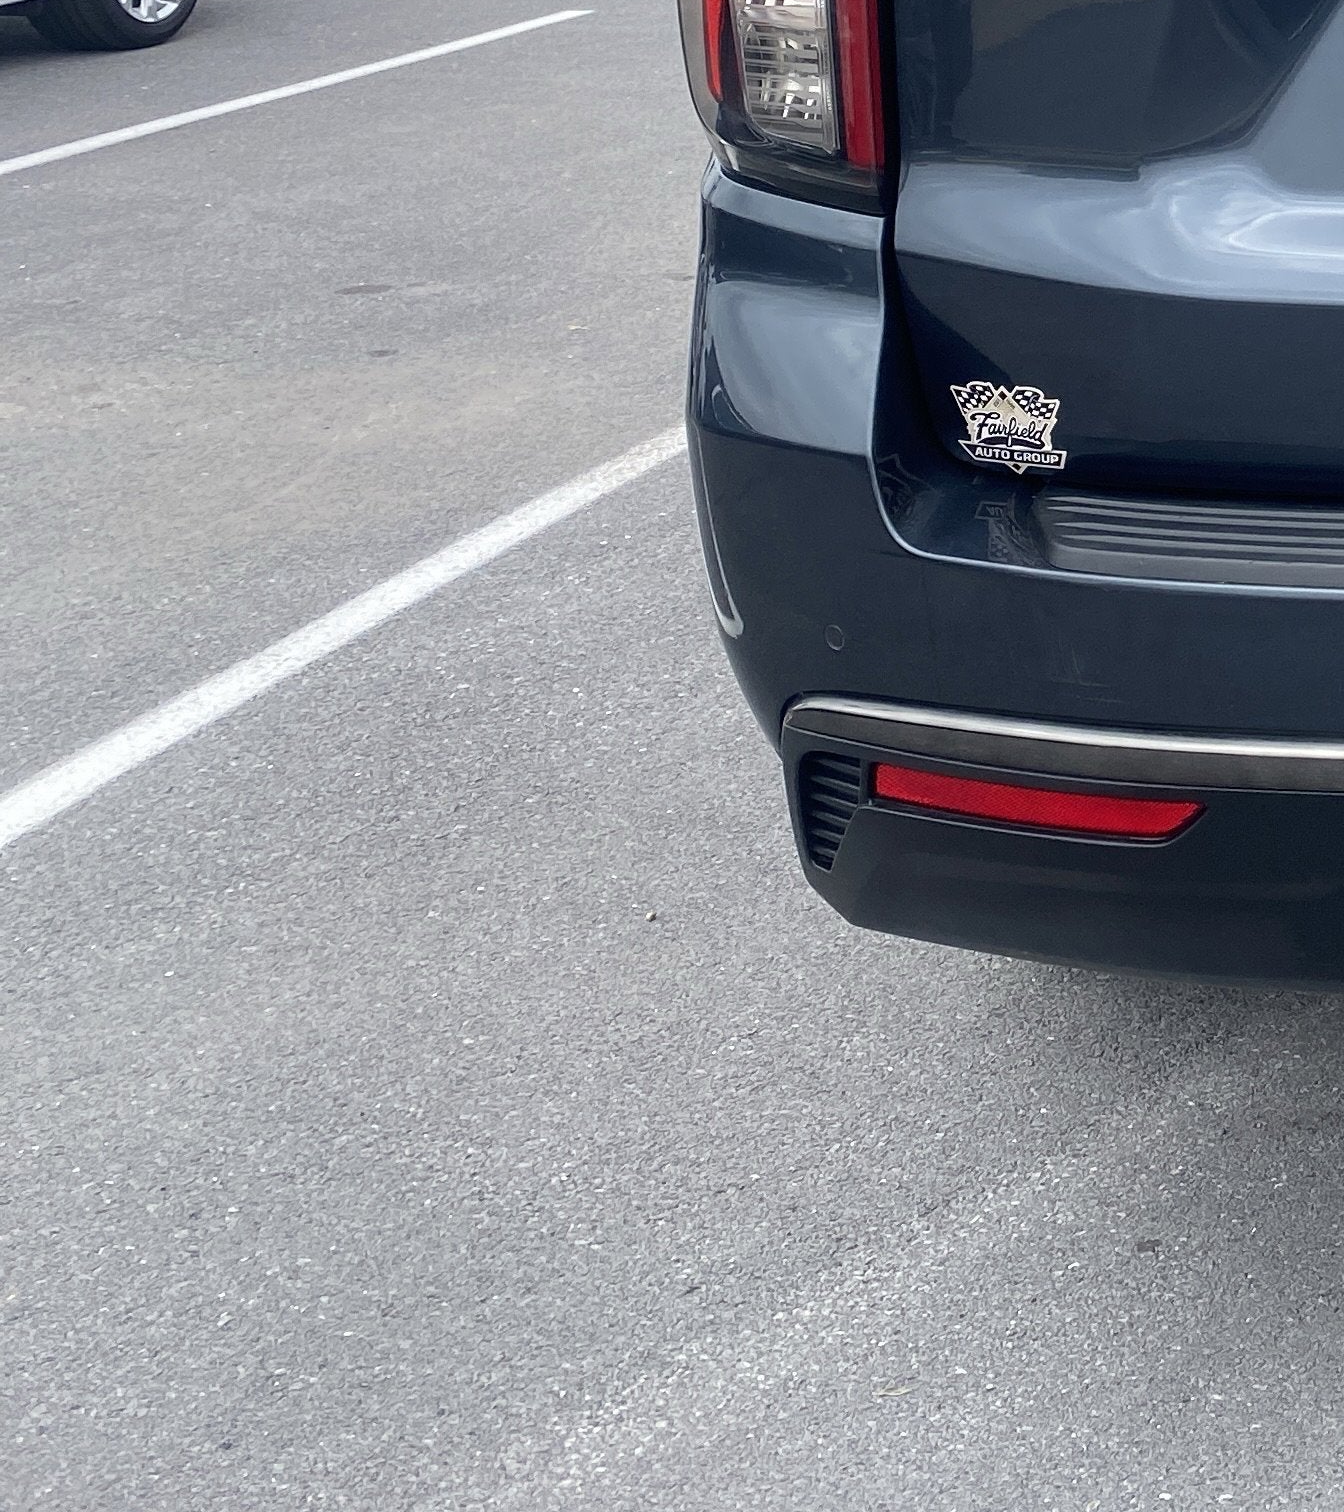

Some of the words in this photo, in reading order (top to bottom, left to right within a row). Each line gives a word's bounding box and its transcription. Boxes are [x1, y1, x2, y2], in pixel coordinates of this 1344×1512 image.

[970, 412, 1049, 444] Fairfield
[974, 446, 1011, 460] AUTO
[1013, 451, 1060, 464] GROUP
